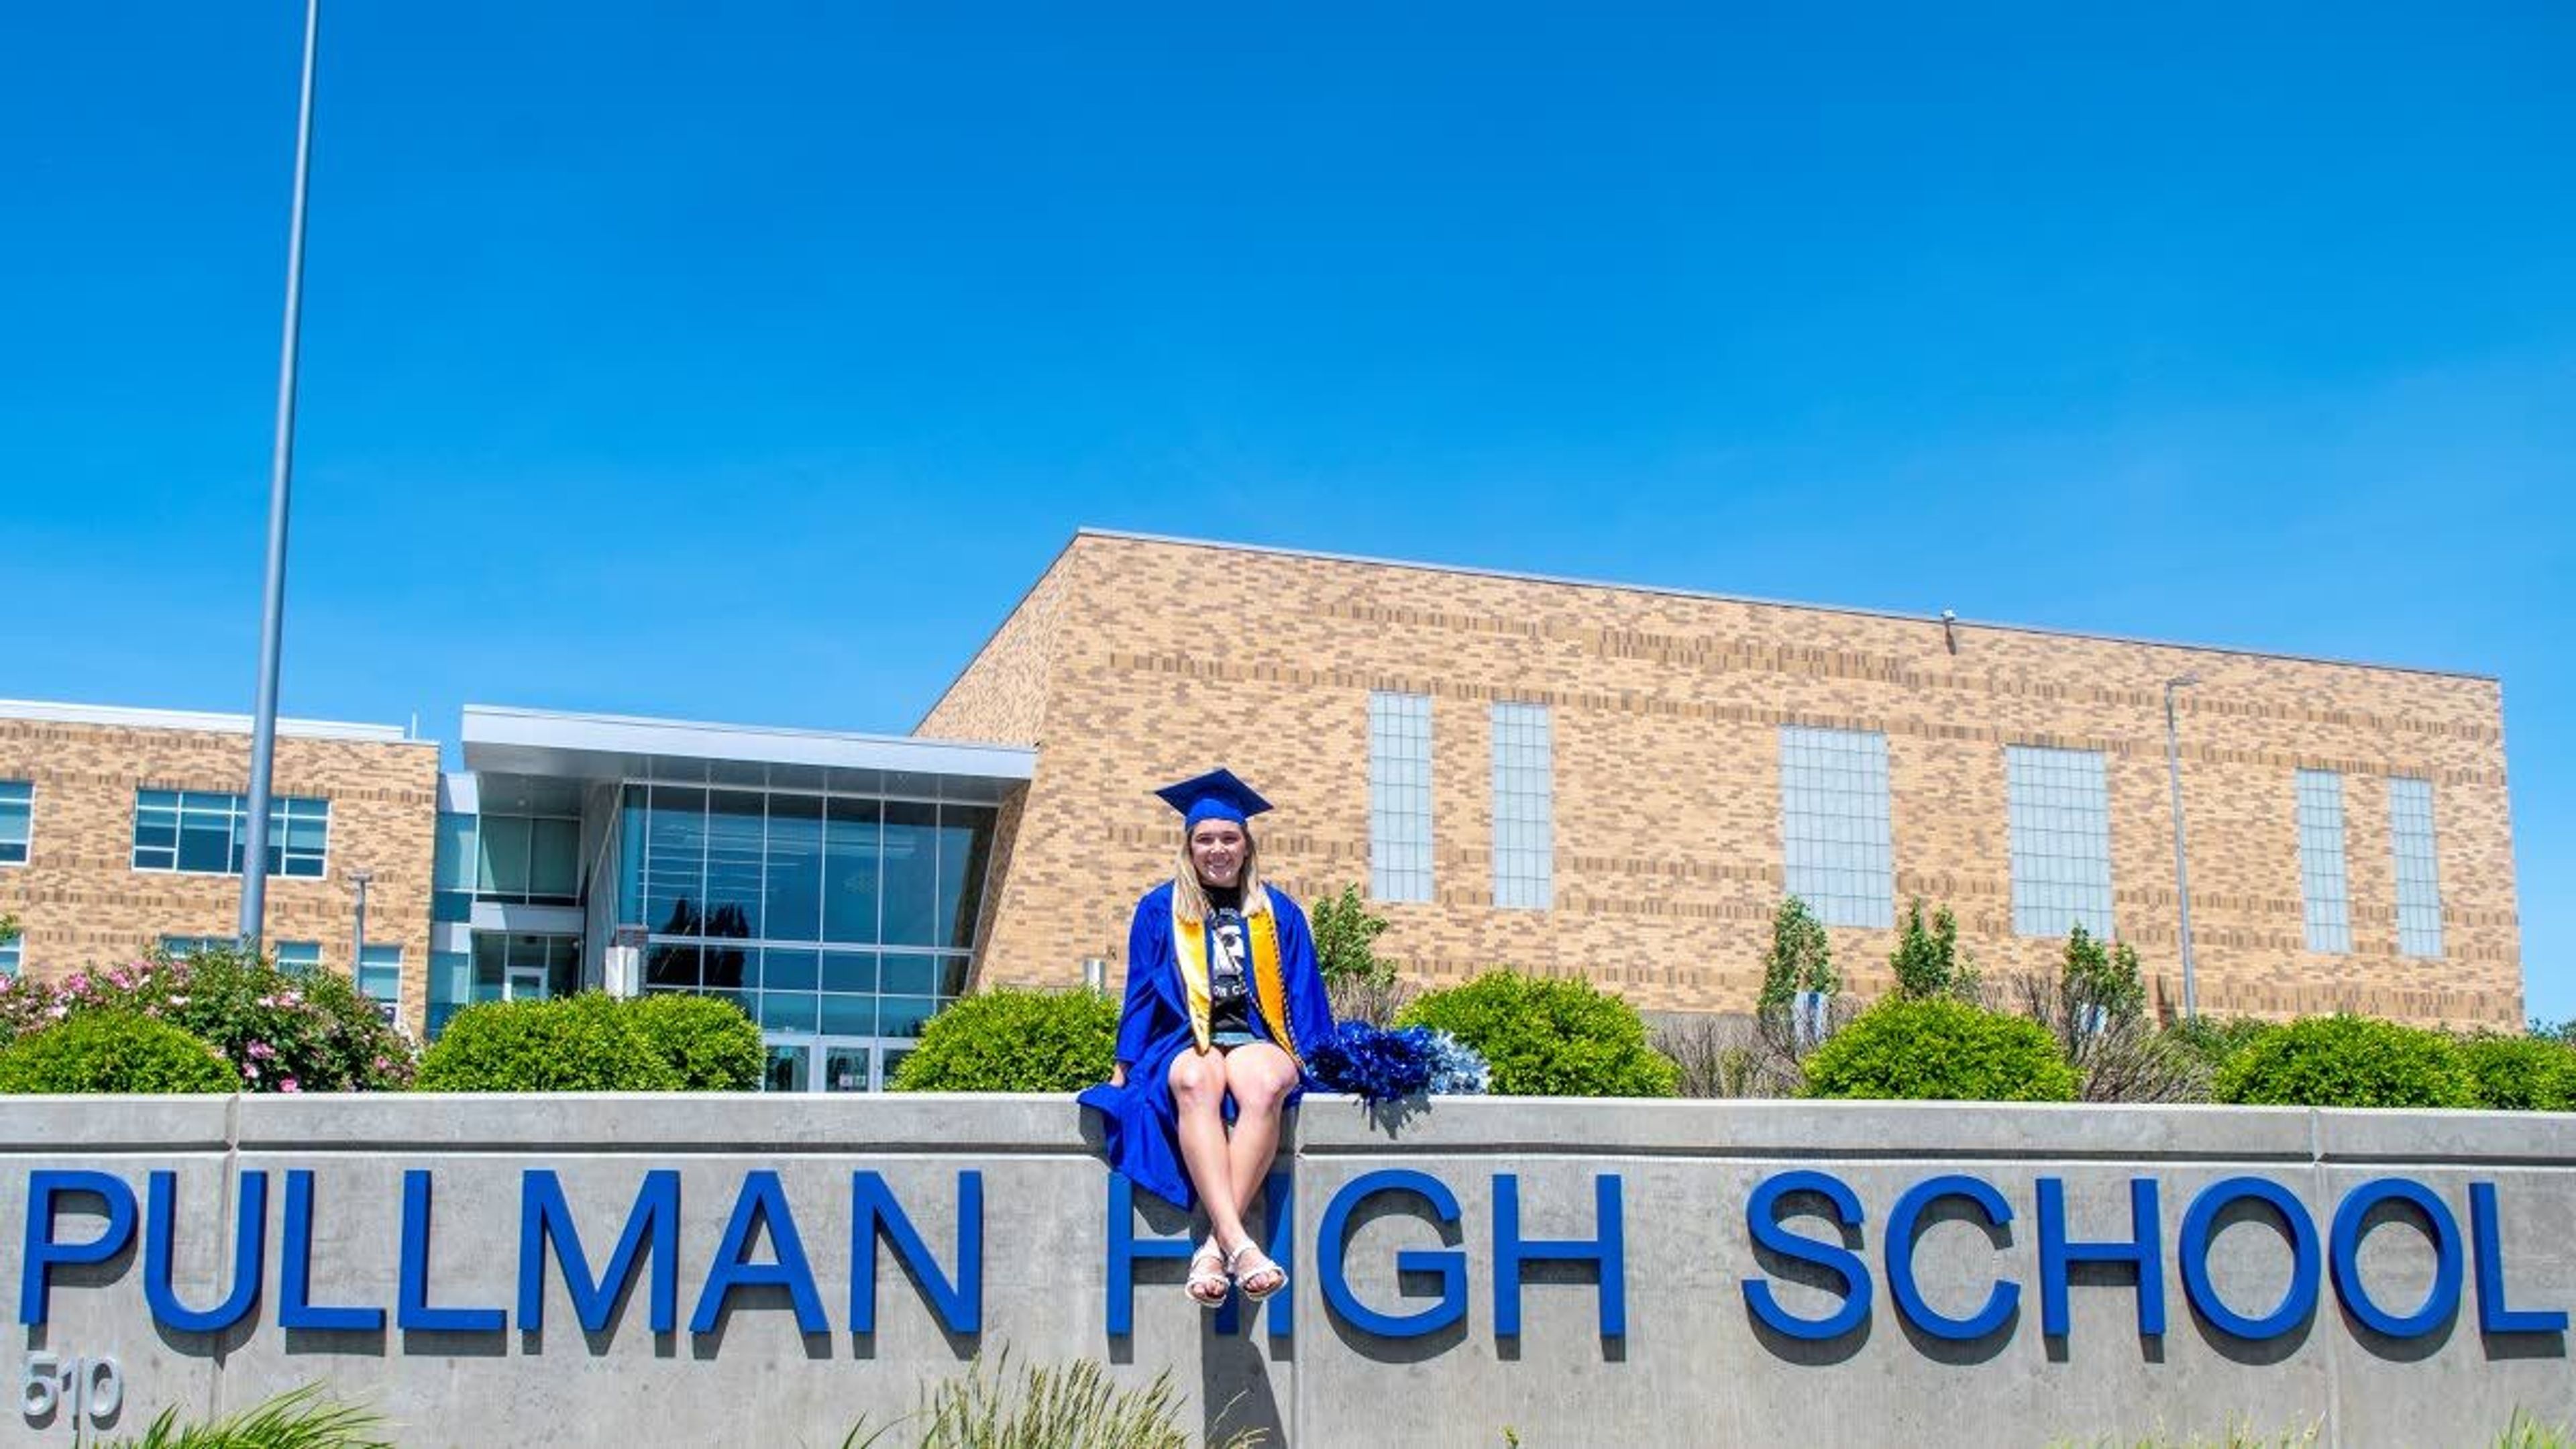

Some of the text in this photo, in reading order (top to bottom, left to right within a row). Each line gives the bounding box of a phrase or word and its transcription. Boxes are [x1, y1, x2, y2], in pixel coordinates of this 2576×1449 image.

[19, 1169, 2569, 1340] PULLMAN HIGH SCHOOL
[21, 1350, 123, 1417] 510
